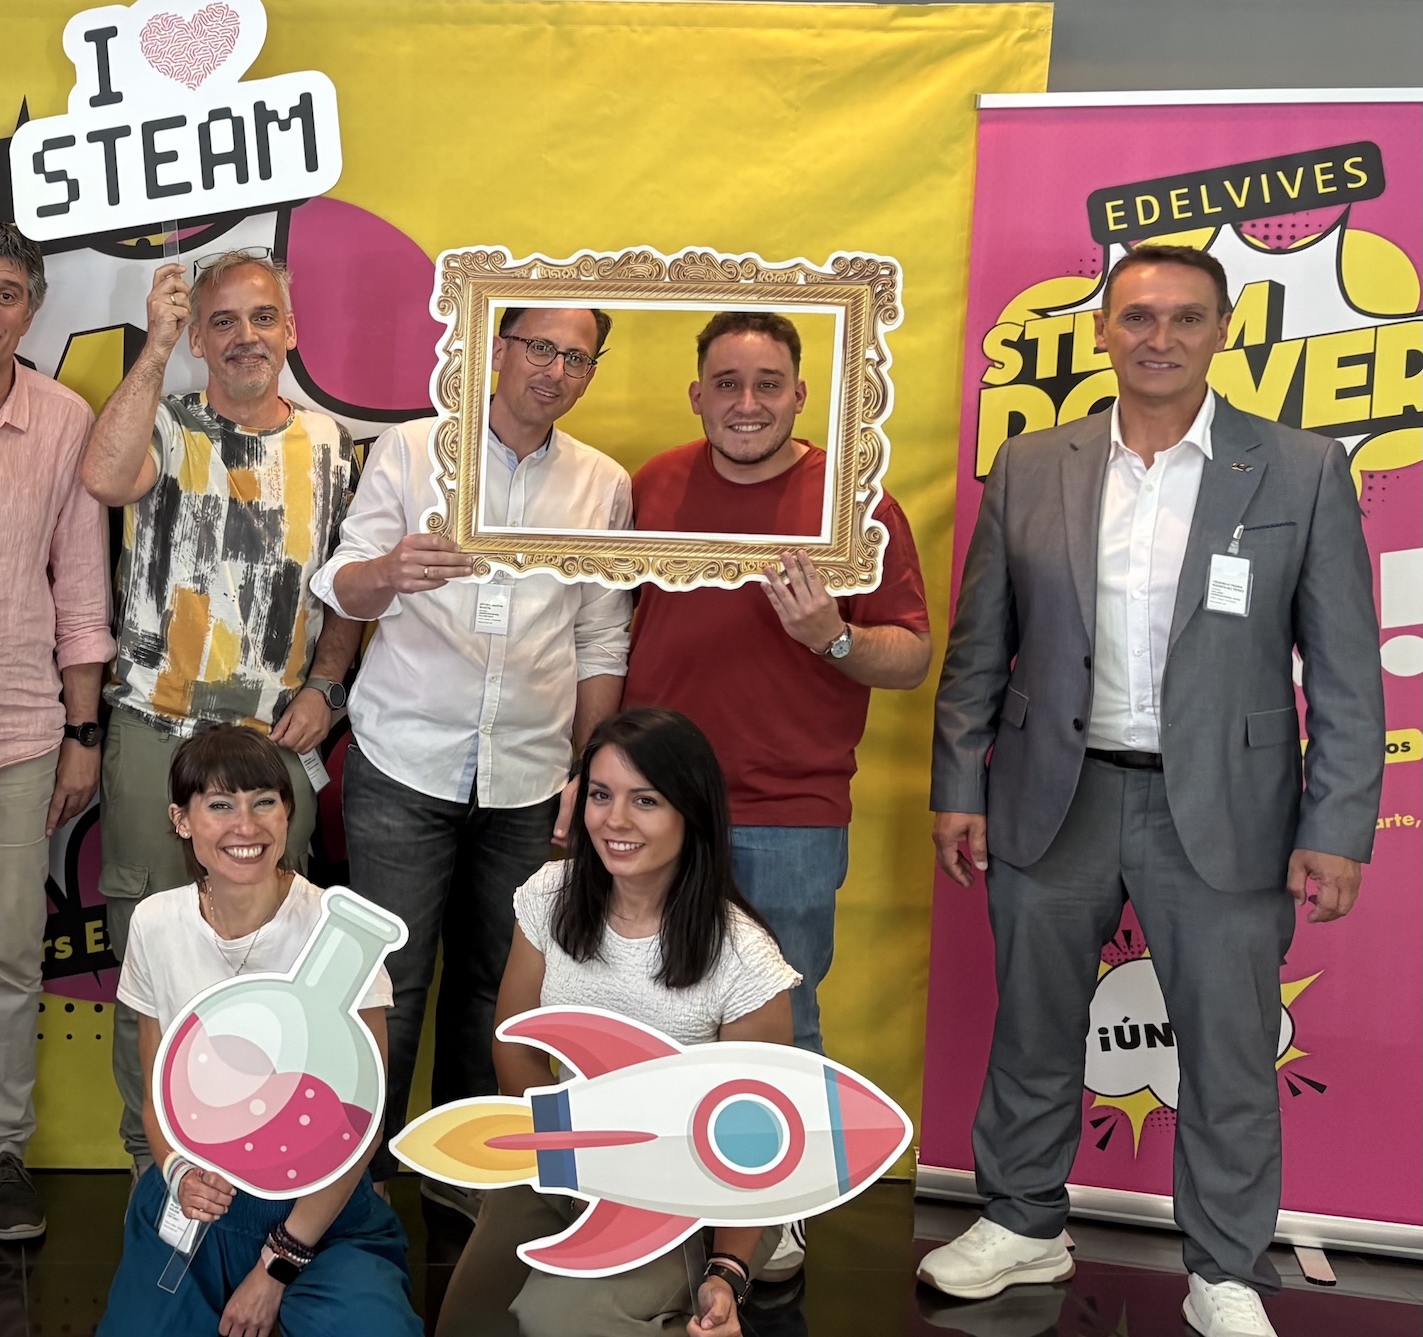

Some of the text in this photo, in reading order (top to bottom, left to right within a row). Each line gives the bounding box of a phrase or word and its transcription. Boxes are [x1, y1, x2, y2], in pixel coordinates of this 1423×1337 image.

[84, 26, 123, 108] I
[33, 92, 319, 218] STEAM
[1105, 156, 1369, 232] EDELVIVES
[1385, 741, 1411, 754] os
